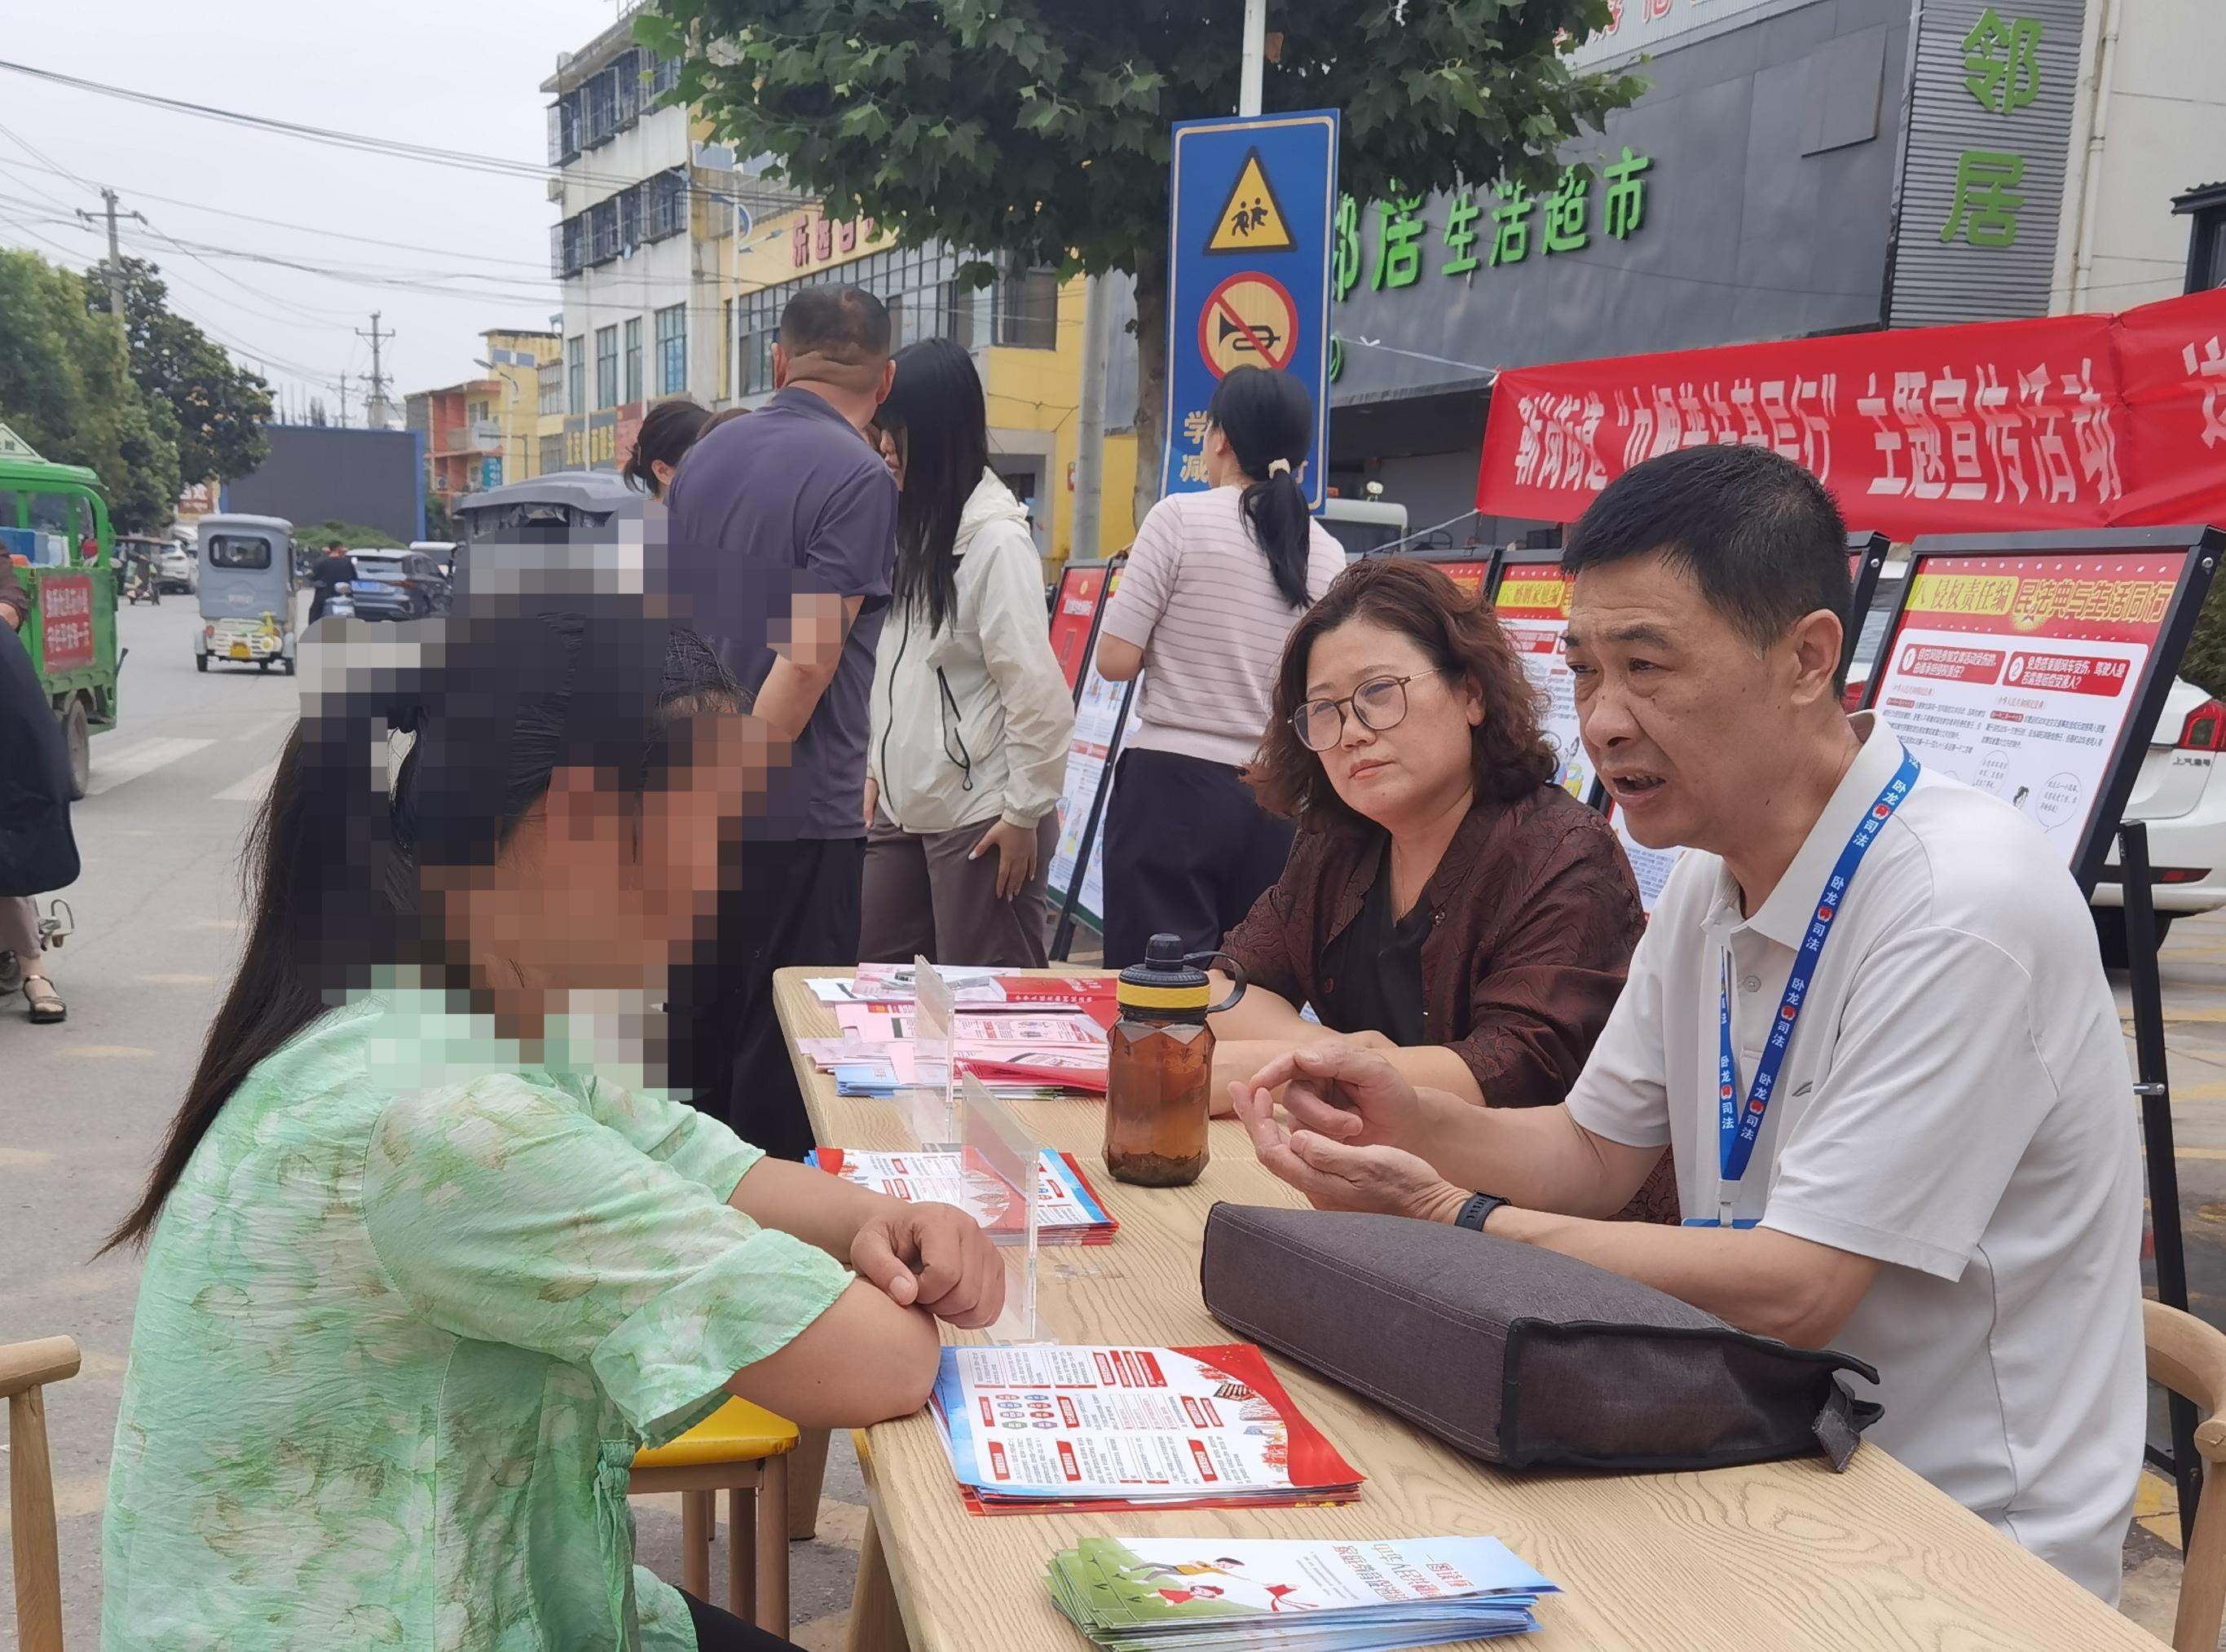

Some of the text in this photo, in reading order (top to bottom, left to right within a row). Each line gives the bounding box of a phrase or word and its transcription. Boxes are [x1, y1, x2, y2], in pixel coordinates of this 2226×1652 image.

[1940, 7, 2043, 247] 邻居
[1930, 578, 2013, 611] 侵权责任编
[2013, 578, 2176, 623] 民法典与生活同行
[1333, 1544, 1409, 1600] 家庭教育促进法
[1373, 1544, 1443, 1598] 中华人民共和国
